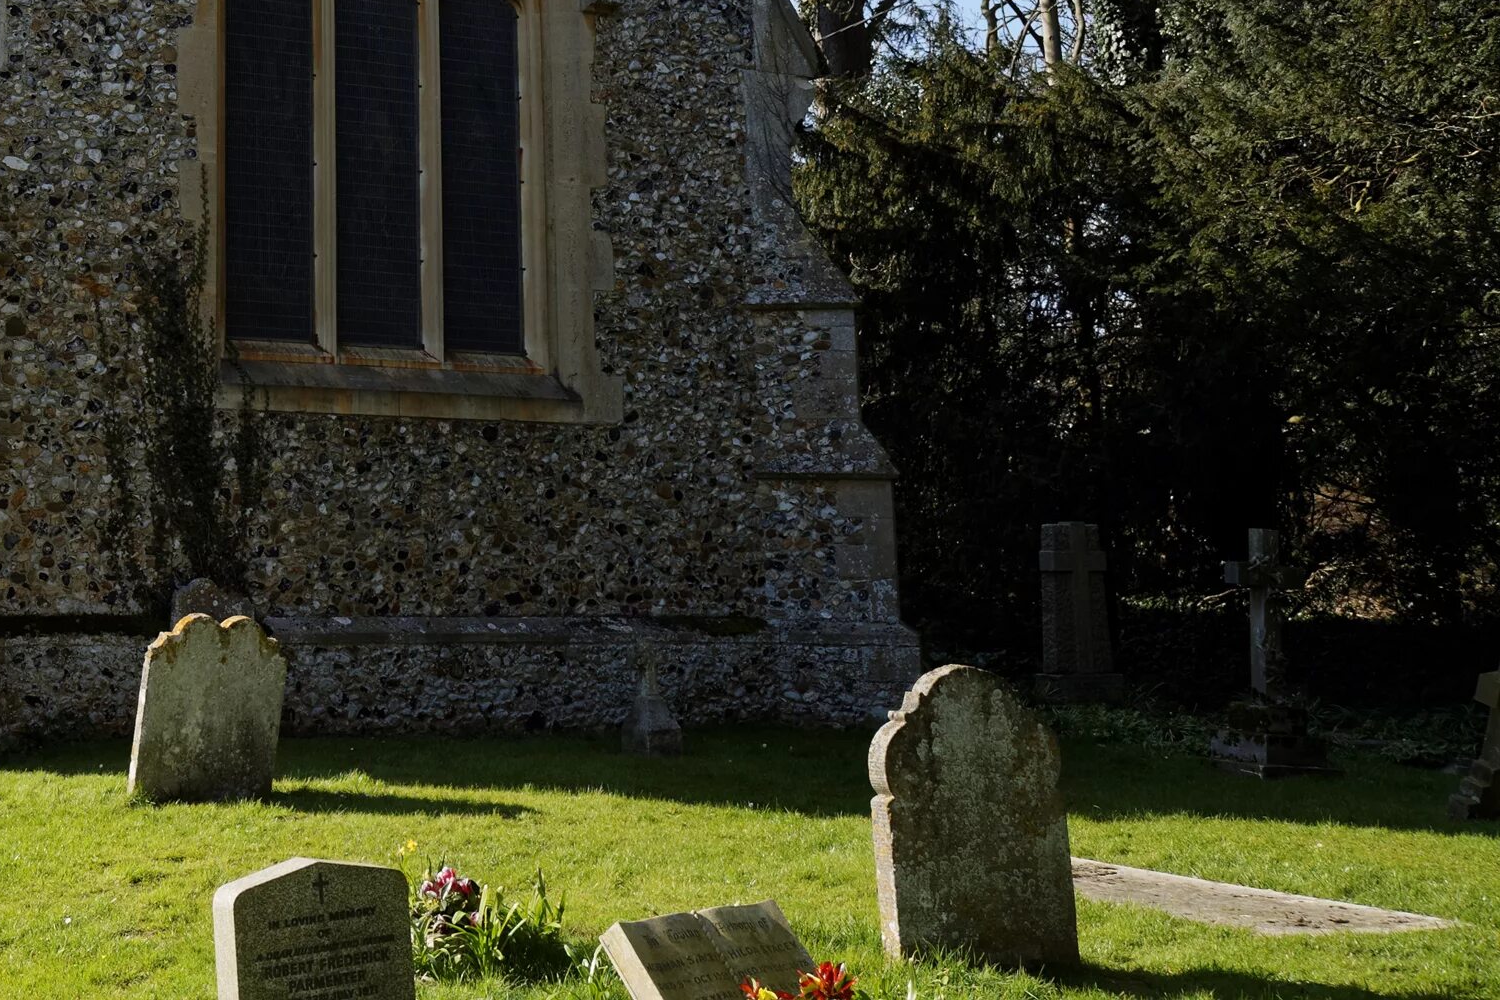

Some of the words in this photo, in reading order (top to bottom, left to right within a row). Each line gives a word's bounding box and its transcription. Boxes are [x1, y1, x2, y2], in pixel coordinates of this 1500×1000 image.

[269, 920, 280, 930] IN
[285, 914, 324, 928] LOVING
[329, 906, 376, 921] MEMORY
[317, 928, 332, 938] OF
[727, 946, 758, 960] HILDA
[759, 940, 797, 954] STACEY
[264, 960, 314, 980] ROBERT
[319, 950, 391, 971] FREDERICK
[288, 970, 367, 993] PARMENTER
[694, 973, 713, 984] OCT
